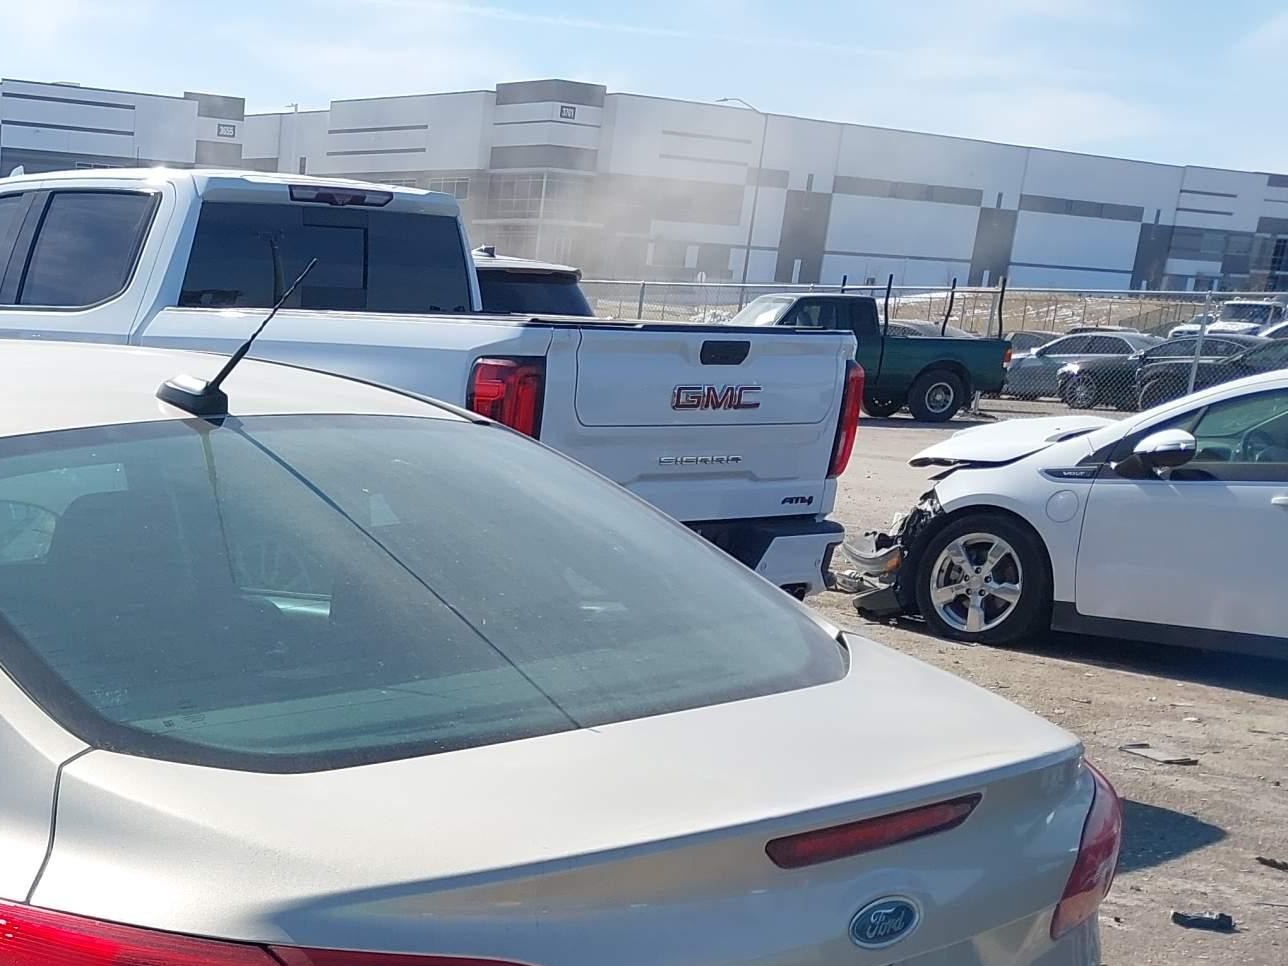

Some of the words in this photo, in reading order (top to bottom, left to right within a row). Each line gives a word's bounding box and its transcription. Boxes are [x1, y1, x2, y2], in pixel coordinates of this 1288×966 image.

[672, 384, 763, 411] GMC
[659, 455, 742, 465] SIERRA
[781, 496, 813, 505] AT4
[866, 907, 905, 938] Ford
